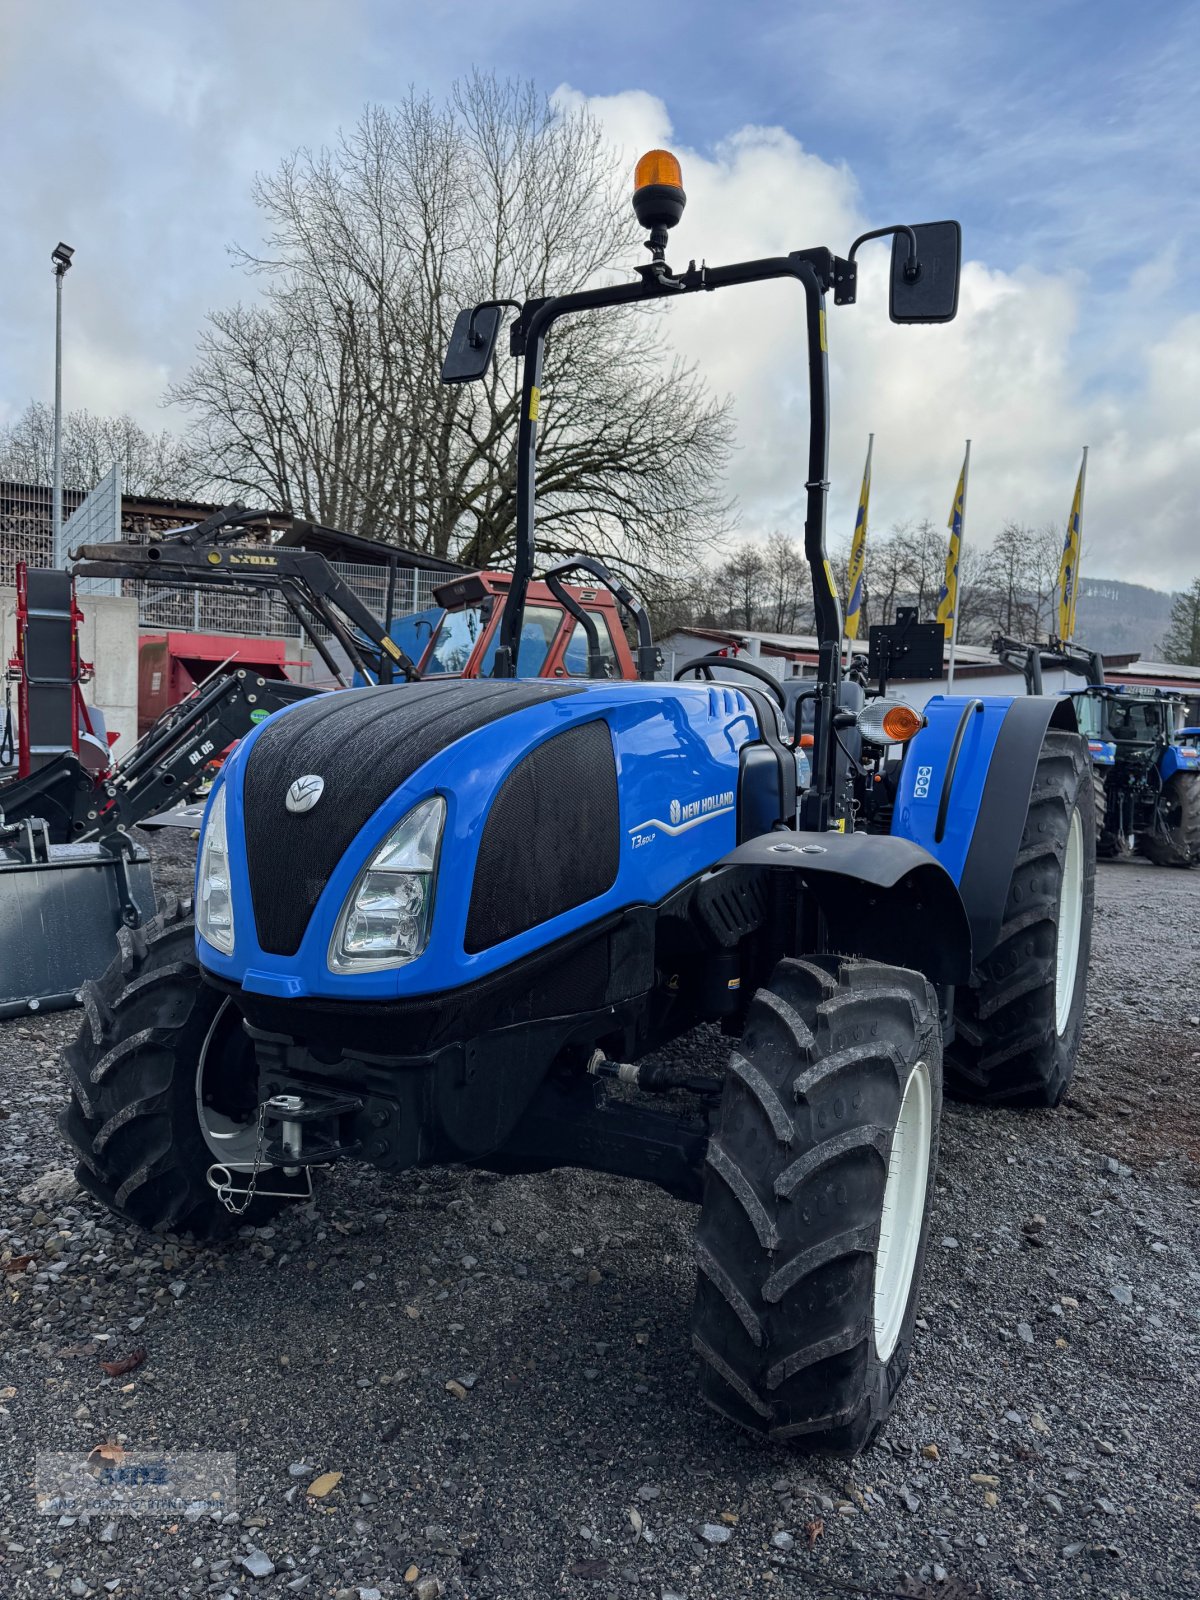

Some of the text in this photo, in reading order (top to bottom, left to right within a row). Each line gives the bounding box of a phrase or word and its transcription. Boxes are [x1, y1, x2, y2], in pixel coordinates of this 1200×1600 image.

[200, 740, 215, 755] 05
[682, 791, 734, 820] NEW HOLLAND
